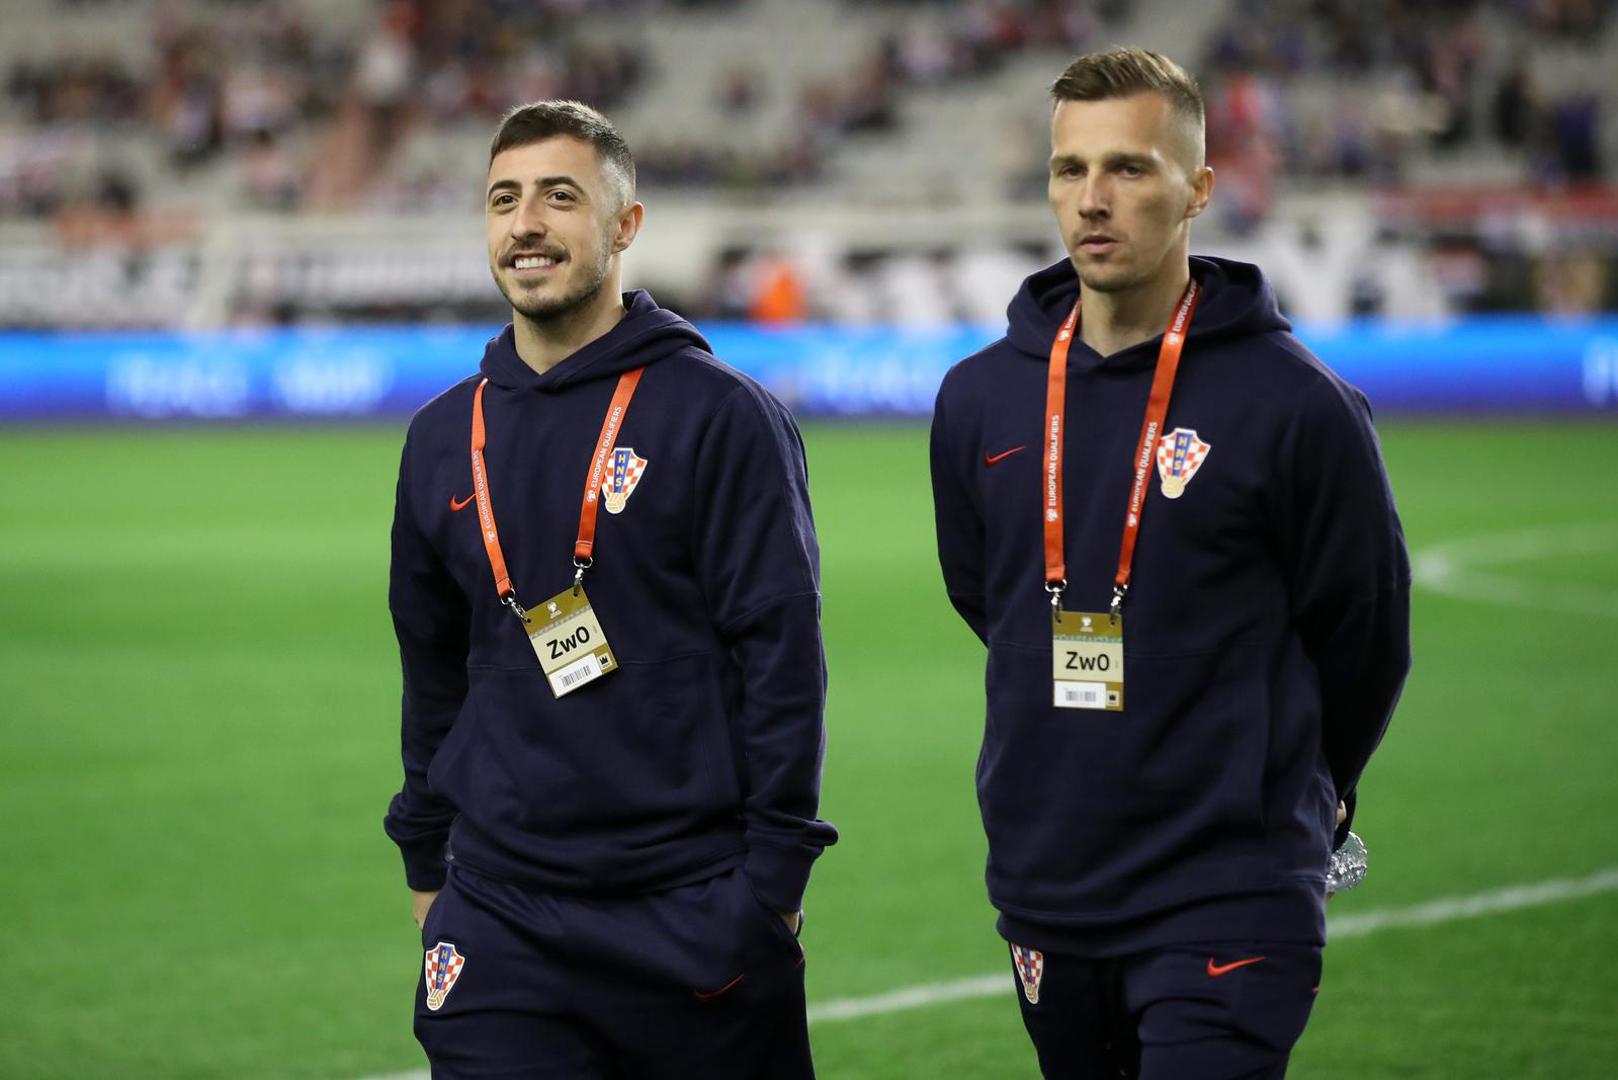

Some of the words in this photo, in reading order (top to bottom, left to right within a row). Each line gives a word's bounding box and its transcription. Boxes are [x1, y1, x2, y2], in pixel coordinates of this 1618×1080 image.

[591, 448, 607, 488] EUROPEAN
[602, 406, 622, 447] QUALIFIERS
[1049, 415, 1060, 462] QUALIFIERS
[615, 454, 626, 488] HNS
[1048, 463, 1057, 505] EUROPEAN
[1131, 468, 1146, 512] EUROPEAN
[1139, 421, 1158, 467] QUALIFIERS
